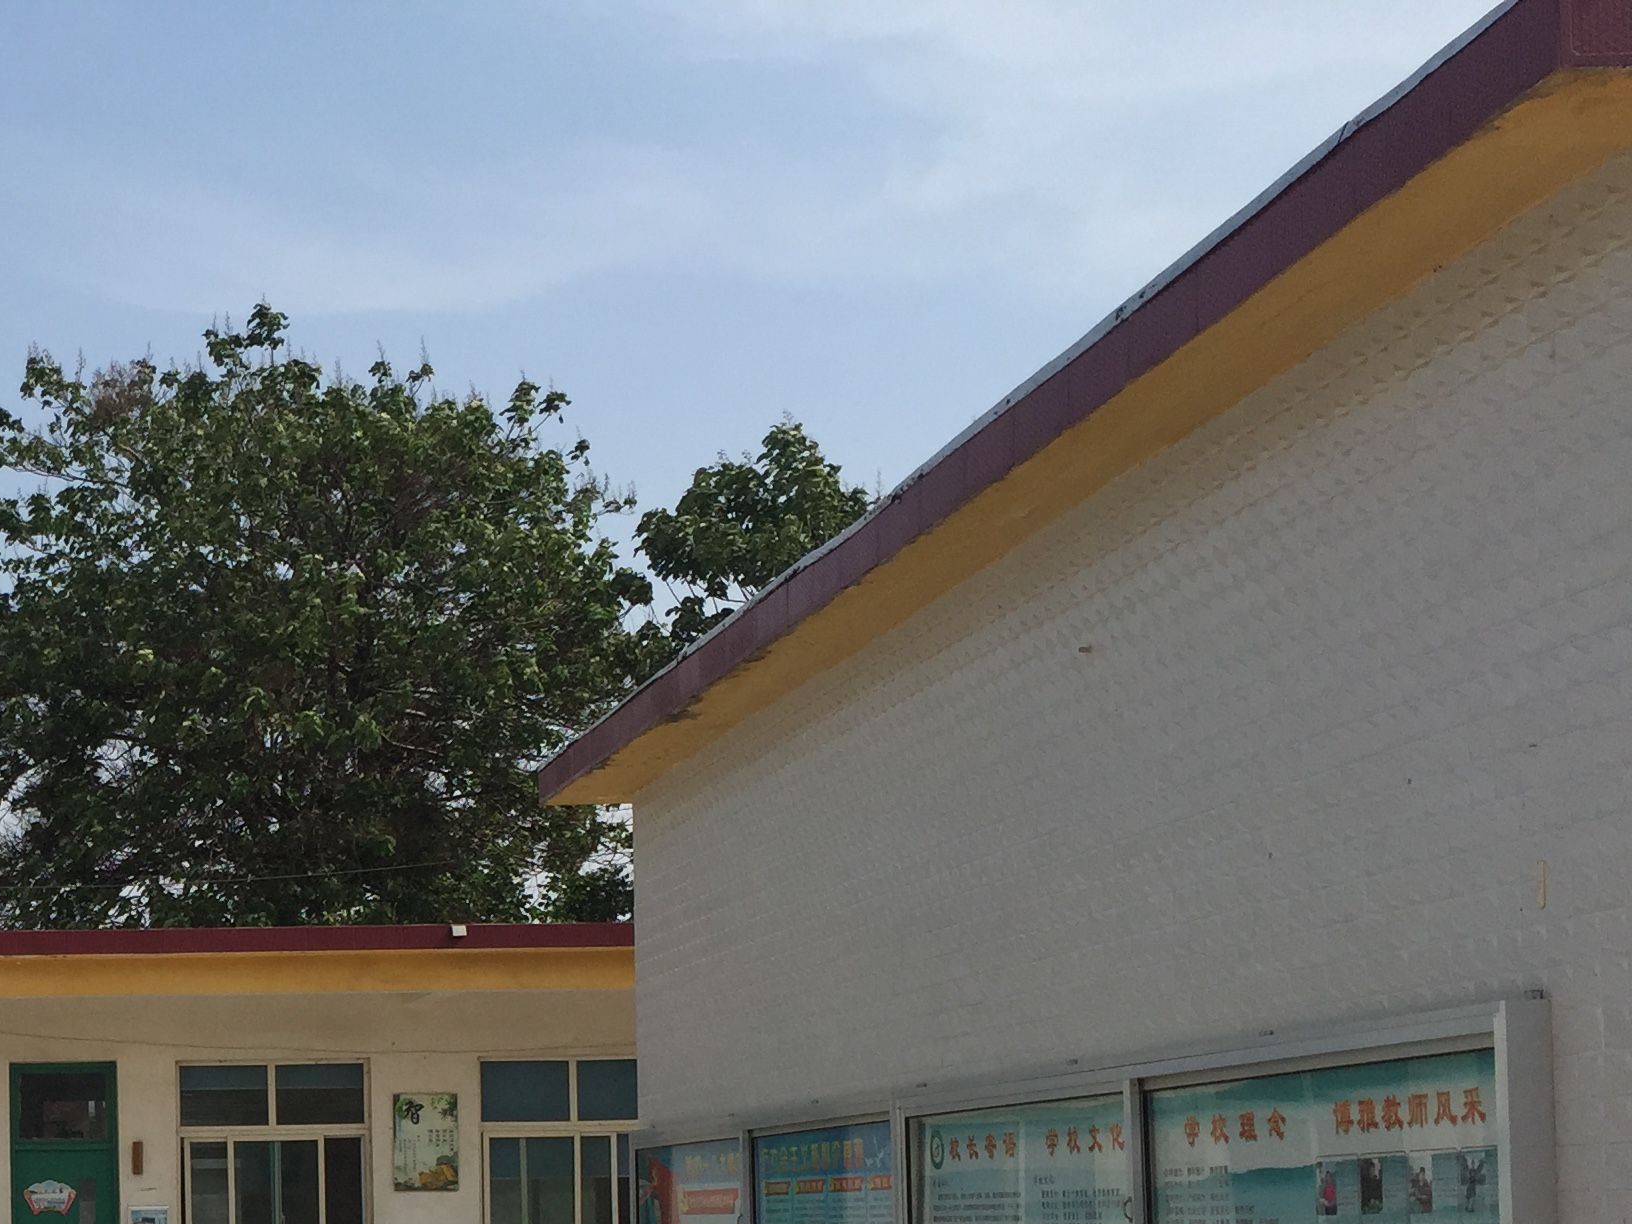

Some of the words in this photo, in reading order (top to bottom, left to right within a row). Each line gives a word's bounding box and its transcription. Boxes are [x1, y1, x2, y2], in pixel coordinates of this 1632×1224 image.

[404, 1100, 425, 1125] 智
[1185, 1107, 1286, 1147] 学校理念
[1332, 1087, 1487, 1135] 博雅教师风采
[949, 1131, 1016, 1161] 校长寄语
[1045, 1122, 1125, 1157] 学校文化
